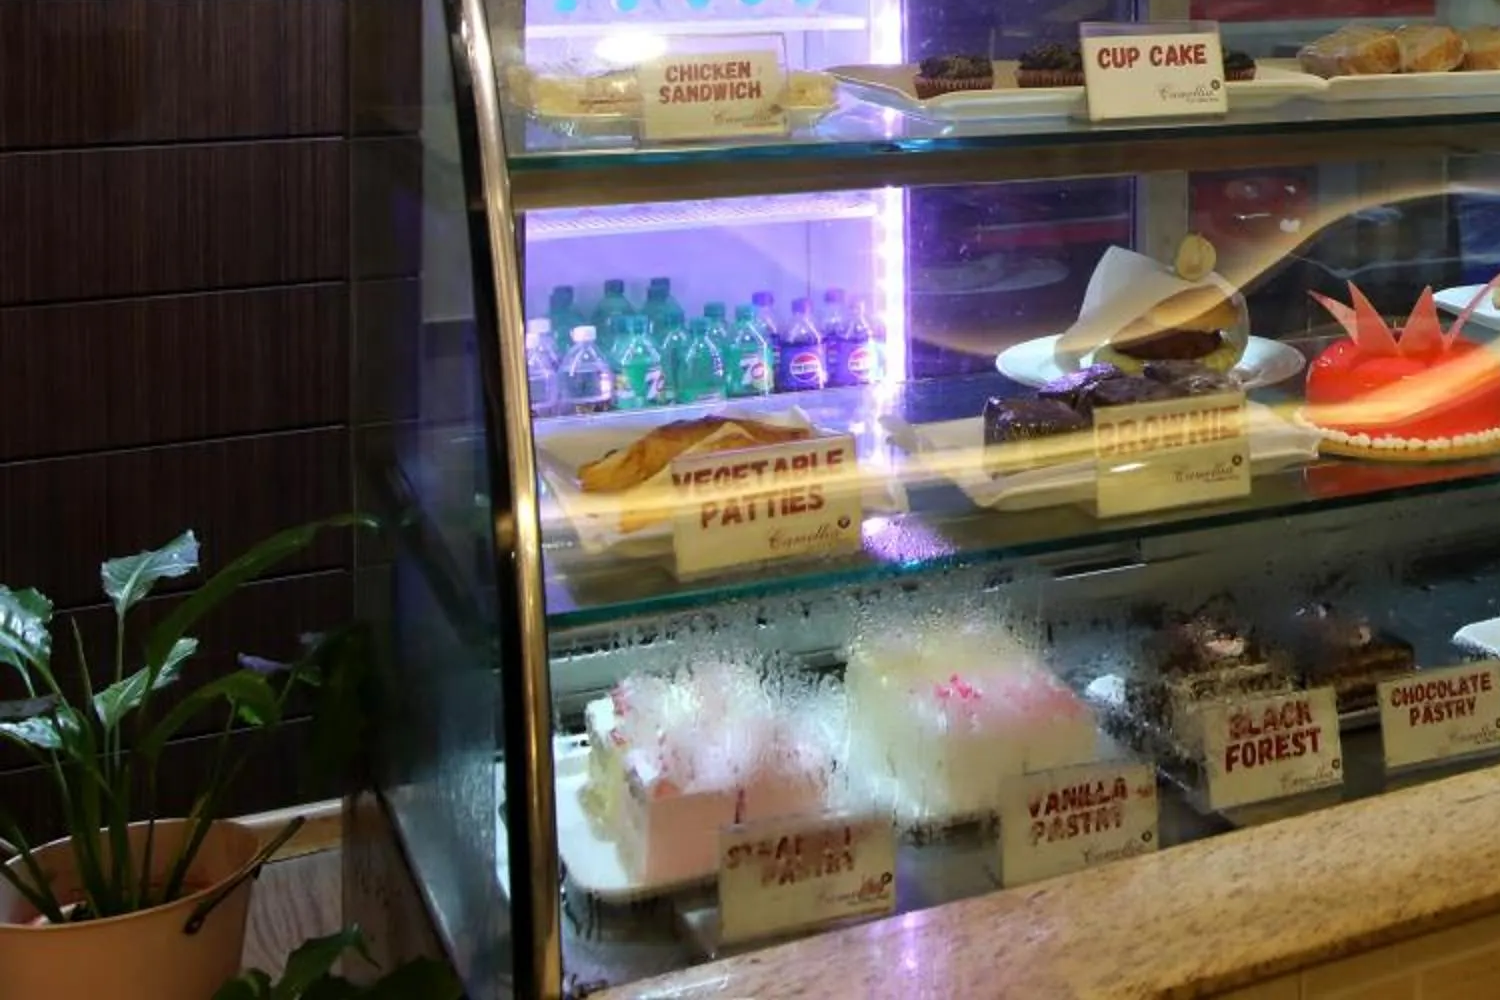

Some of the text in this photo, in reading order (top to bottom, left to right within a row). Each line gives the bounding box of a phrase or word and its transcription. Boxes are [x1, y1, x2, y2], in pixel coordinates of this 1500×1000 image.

[665, 61, 752, 83] CHICKEN
[1097, 43, 1207, 70] CUP CAKE
[659, 80, 762, 104] SANDWICH
[671, 447, 844, 493] VEGETABLE
[700, 485, 826, 530] PATTIES
[1390, 671, 1493, 708] CHOCOLATE
[1228, 700, 1313, 740] BLACK
[1408, 695, 1477, 728] PASTRY
[1224, 727, 1321, 774] FOREST
[1027, 776, 1129, 818] VANILLA
[1029, 804, 1124, 846] PASTRY
